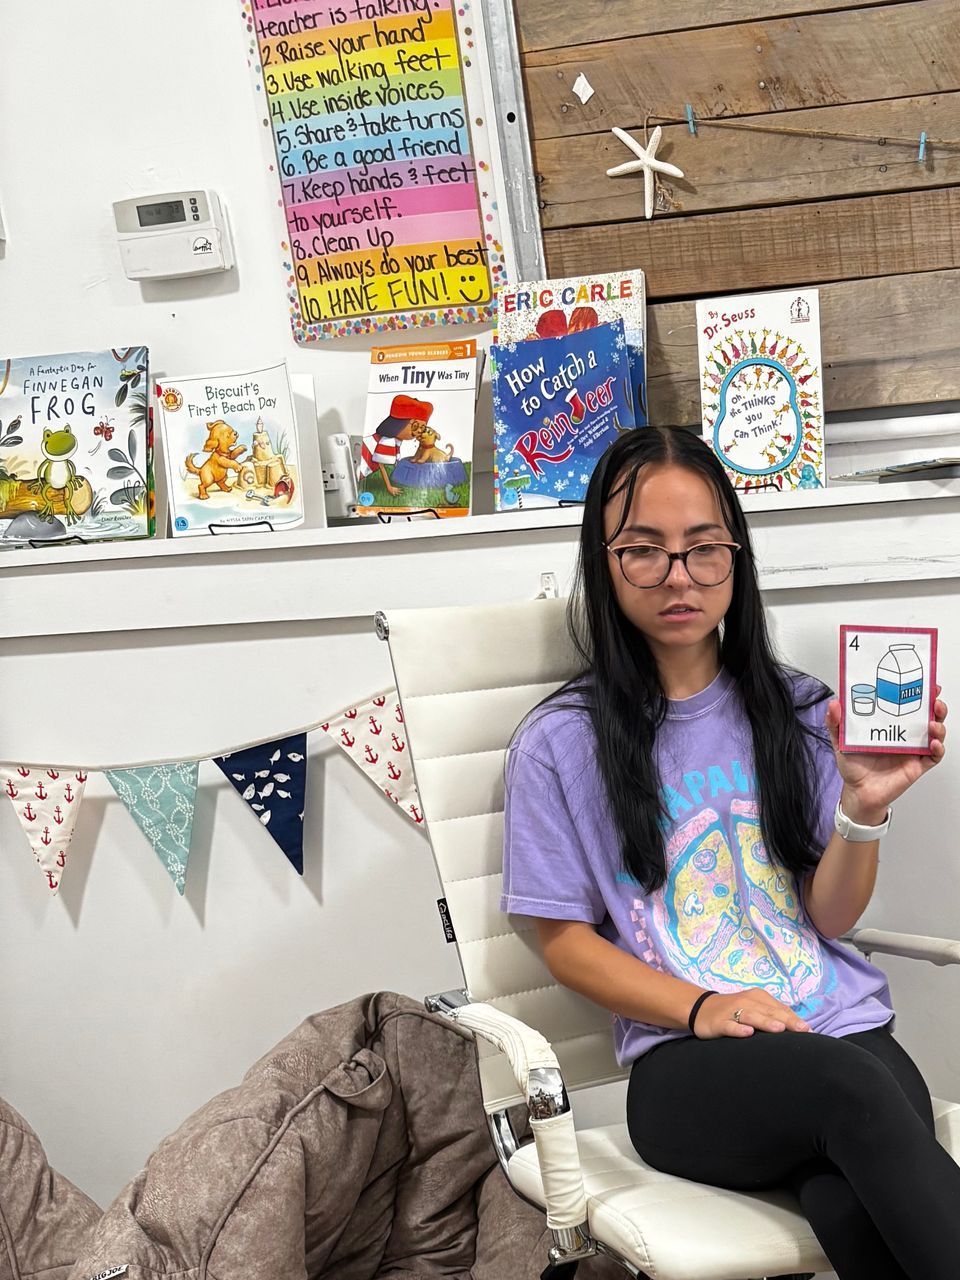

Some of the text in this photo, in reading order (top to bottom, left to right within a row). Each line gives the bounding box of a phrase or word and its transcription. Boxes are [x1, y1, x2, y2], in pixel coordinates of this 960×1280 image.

[256, 11, 323, 38] teacher
[329, 8, 347, 25] is
[328, 33, 371, 59] your
[373, 18, 425, 47] hand
[316, 59, 390, 90] walking
[394, 48, 451, 74] feet
[323, 87, 372, 115] inside
[375, 80, 444, 106] voices
[357, 113, 401, 137] take
[400, 108, 464, 130] turns
[334, 154, 347, 167] a
[353, 139, 395, 175] good
[398, 131, 462, 157] friend
[349, 167, 404, 195] hands
[422, 162, 476, 184] feet
[289, 197, 402, 234] to yourself.
[367, 227, 394, 255] Up
[380, 253, 400, 274] do
[403, 253, 437, 282] your
[444, 242, 489, 267] best
[388, 272, 450, 308] FUN!
[503, 280, 633, 313] ERIC CARLE
[703, 308, 756, 340] Dr. Seuss
[708, 310, 719, 319] By
[23, 376, 103, 395] FINNEGAN
[29, 367, 35, 376] A
[379, 365, 470, 388] When Tiny Was Tiny
[505, 356, 546, 397] How
[520, 350, 598, 416] to Catch a
[188, 403, 217, 417] First
[221, 399, 255, 414] Beach
[258, 396, 276, 409] Day
[205, 382, 260, 400] Biscuit's
[31, 392, 95, 424] FROG
[730, 408, 742, 418] the
[849, 634, 860, 651] 4
[870, 724, 907, 742] milk
